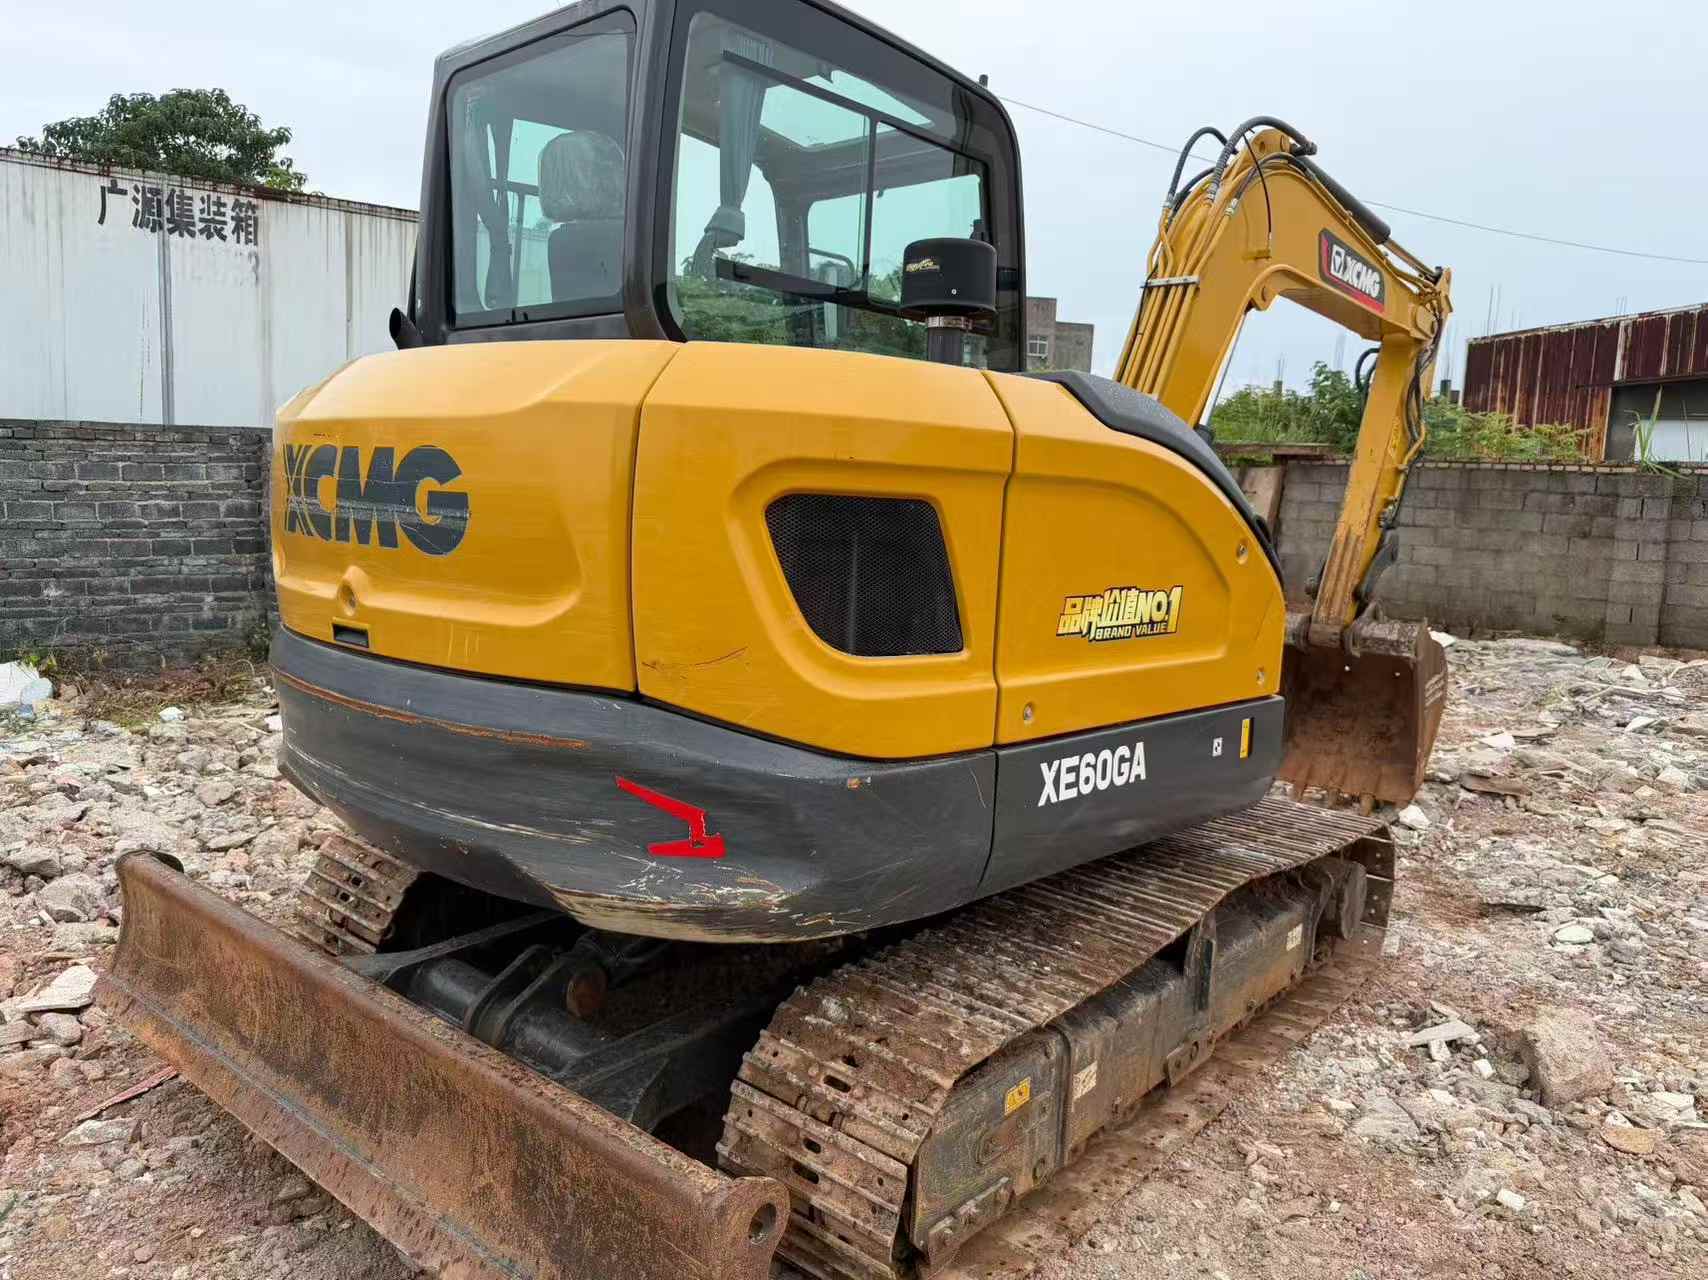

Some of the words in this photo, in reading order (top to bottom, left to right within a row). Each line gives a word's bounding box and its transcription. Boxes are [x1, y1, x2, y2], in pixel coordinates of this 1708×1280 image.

[98, 179, 259, 246] 广源集装箱
[1343, 255, 1380, 298] XCMG
[283, 443, 469, 556] XCMG
[1095, 625, 1133, 640] BRAND
[1134, 621, 1168, 637] VALUE
[1038, 741, 1147, 807] XE60GA
